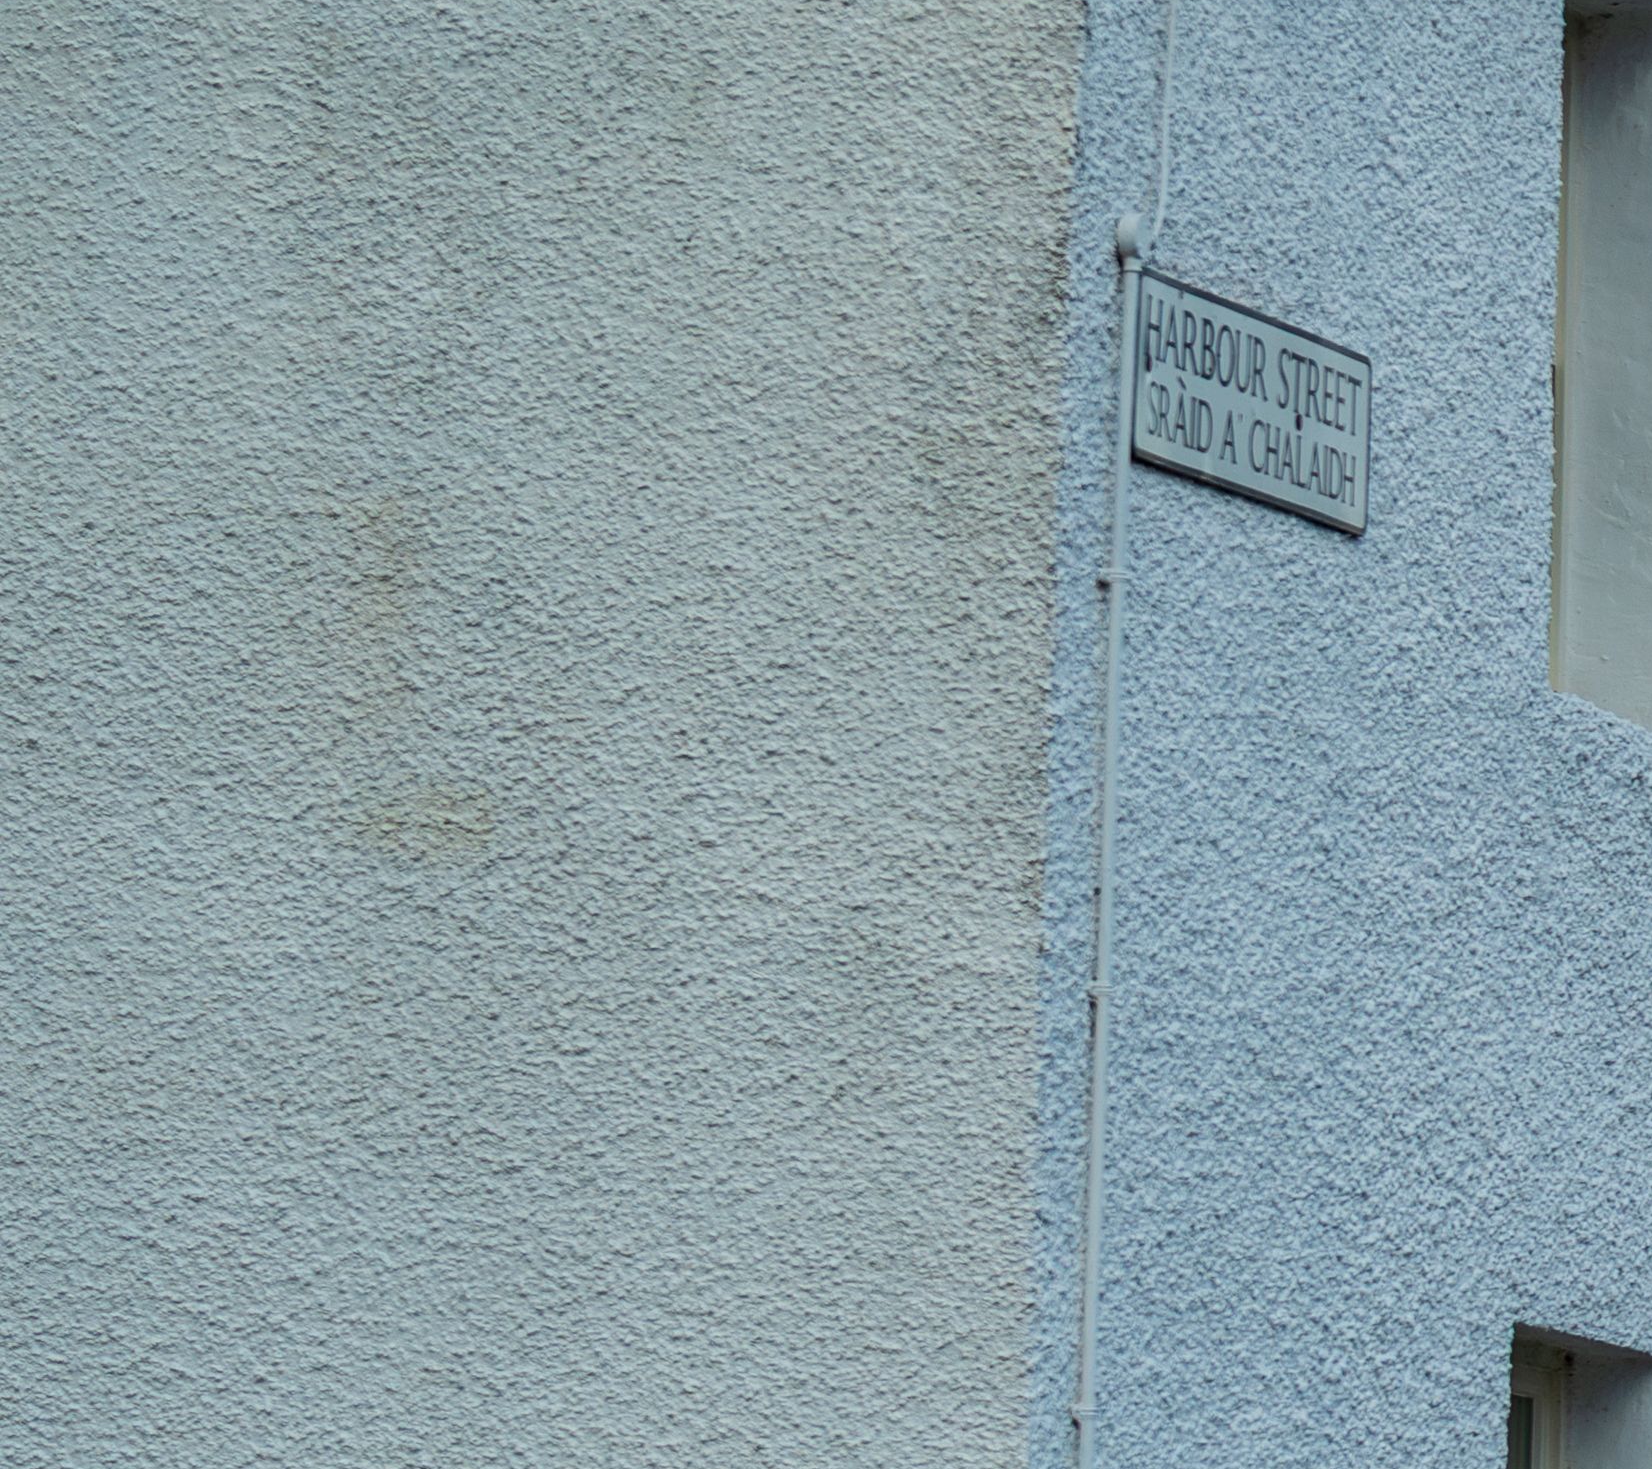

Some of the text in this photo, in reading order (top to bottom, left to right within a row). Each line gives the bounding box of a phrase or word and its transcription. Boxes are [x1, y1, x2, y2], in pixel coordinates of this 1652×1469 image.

[1146, 295, 1362, 436] HARBOUR STREET
[1147, 376, 1213, 453] SRÀID
[1250, 419, 1356, 507] CHALAIDH
